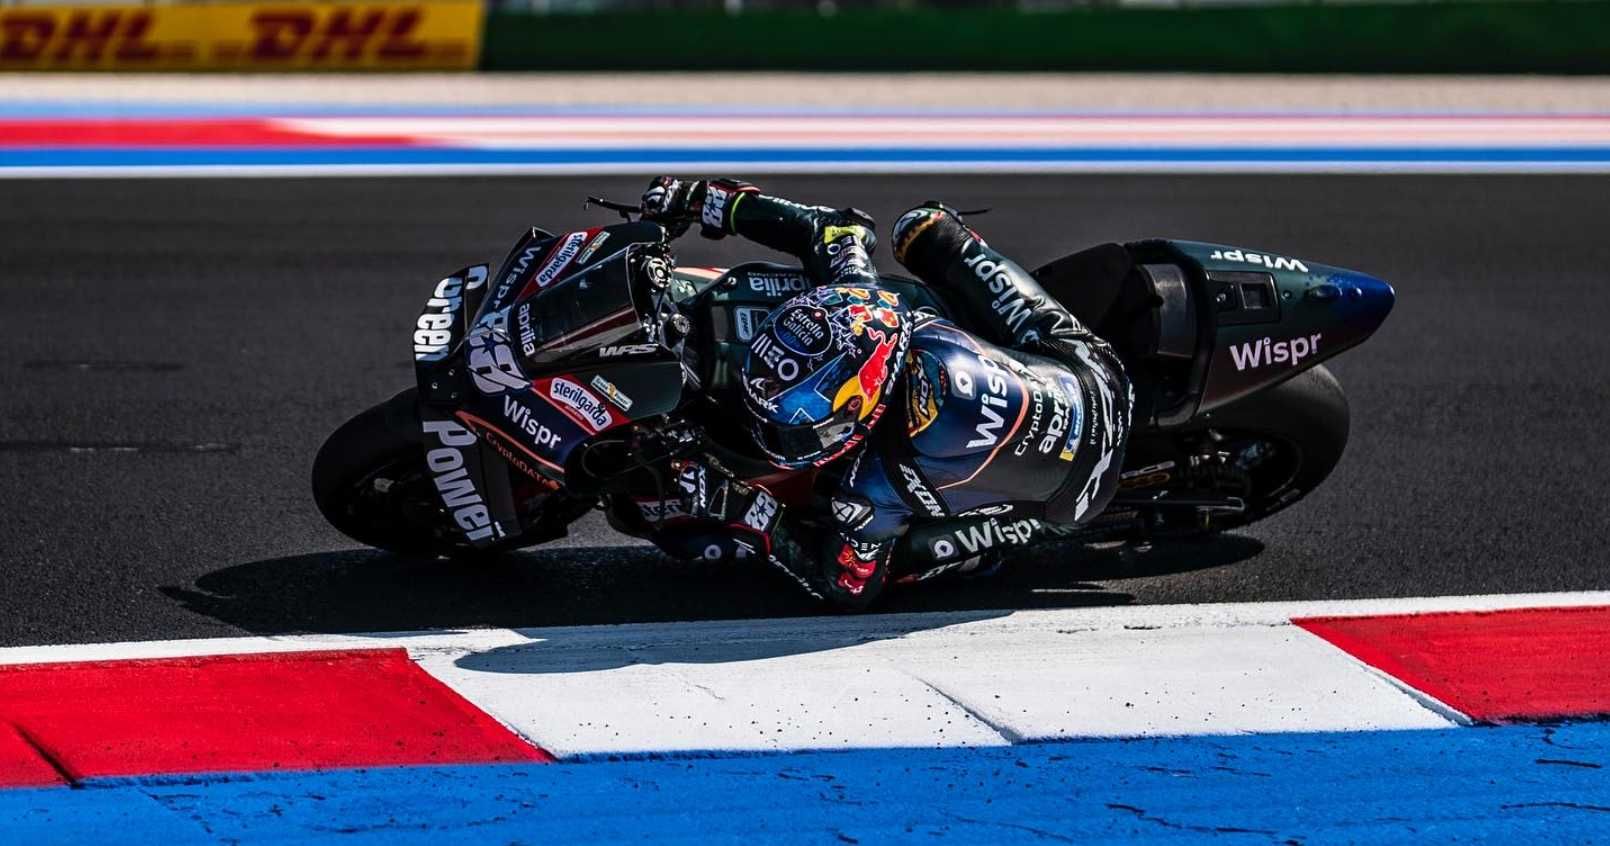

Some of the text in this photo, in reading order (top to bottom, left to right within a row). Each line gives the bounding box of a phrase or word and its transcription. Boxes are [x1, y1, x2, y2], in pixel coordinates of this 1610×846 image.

[1, 13, 158, 61] DHL
[250, 10, 426, 60] DHL
[493, 246, 542, 309] Wispr
[1210, 250, 1308, 272] Wispr
[963, 253, 1033, 334] Wispr
[518, 303, 536, 356] aprilia
[783, 319, 814, 347] Galicia
[790, 308, 825, 340] Estrella
[1230, 332, 1322, 371] Wispr
[503, 394, 562, 449] Wispr
[553, 379, 607, 428] sterilgarda
[966, 354, 1010, 448] Wisp
[1014, 389, 1043, 457] CryptoD
[423, 420, 507, 542] Power
